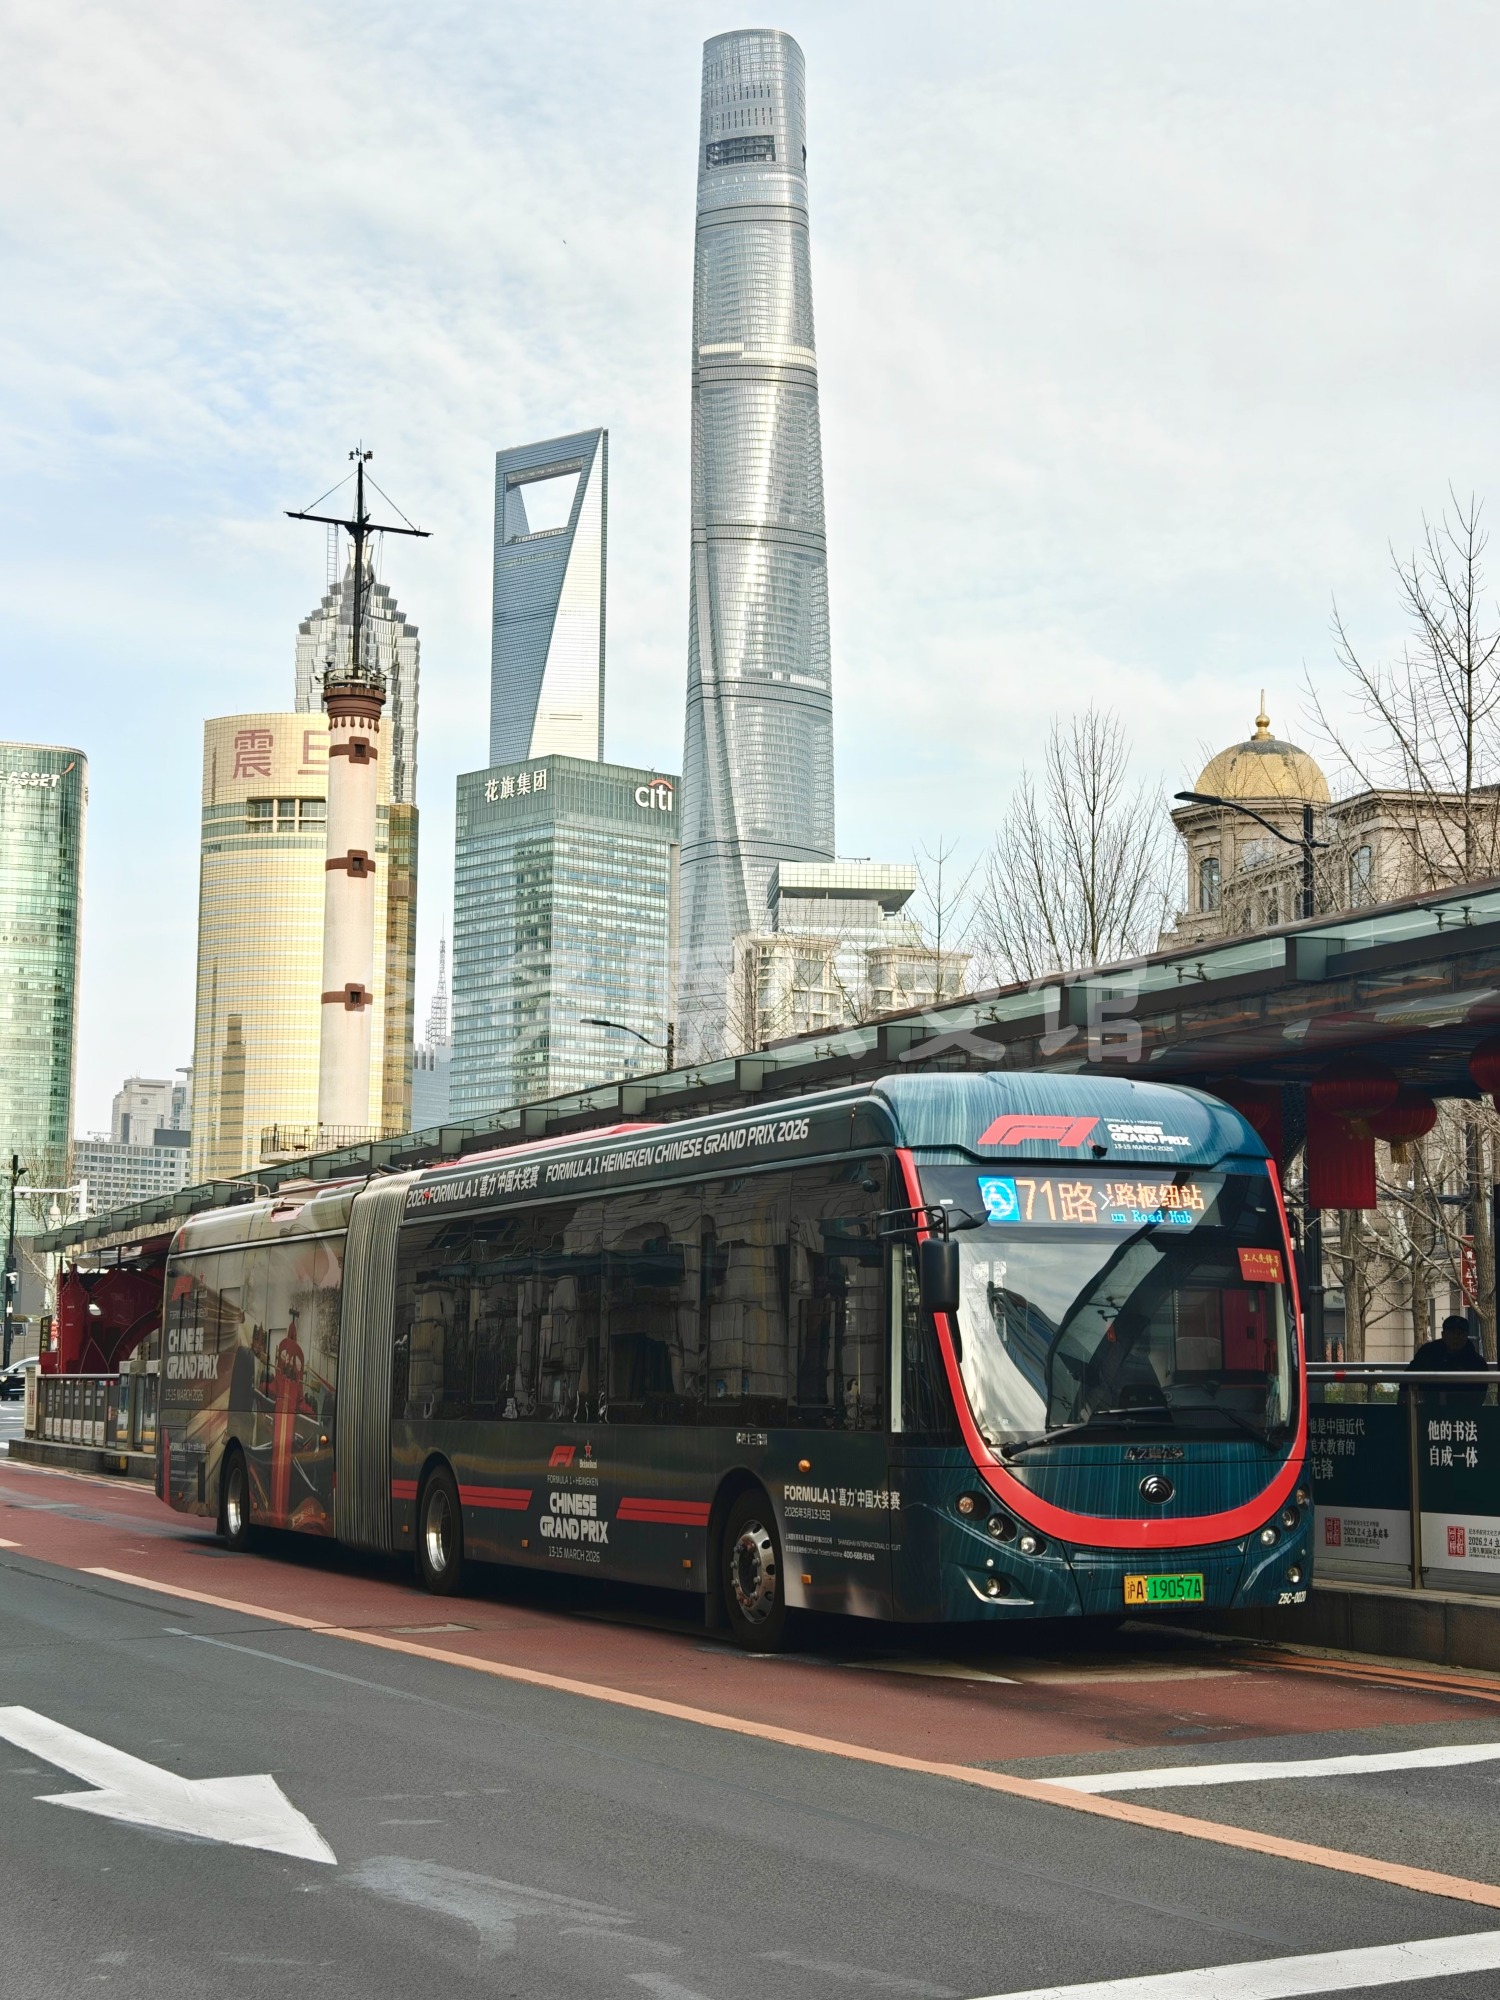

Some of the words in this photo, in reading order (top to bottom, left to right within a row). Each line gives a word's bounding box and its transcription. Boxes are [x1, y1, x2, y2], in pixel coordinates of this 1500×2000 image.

[7, 771, 61, 788] ASSET
[485, 768, 547, 803] 花旗集团
[635, 779, 673, 811] citi
[1107, 1123, 1164, 1135] CHINESE
[1111, 1132, 1158, 1144] GRAND
[1158, 1135, 1191, 1146] PRIX
[546, 1158, 592, 1182] FORMULA
[592, 1156, 599, 1175] 1
[600, 1146, 656, 1173] HEINEKEN
[654, 1136, 704, 1164] CHINESE
[704, 1128, 746, 1155] GRAND
[747, 1122, 778, 1147] PRIX
[777, 1117, 810, 1143] 2026
[428, 1179, 472, 1205] FORMULA
[1015, 1179, 1097, 1222] 71路
[1134, 1210, 1164, 1224] Road
[1169, 1211, 1193, 1224] Hub
[167, 1355, 197, 1379] GRAND
[196, 1354, 219, 1379] PRIX
[1428, 1419, 1478, 1442] 他的书法
[1429, 1445, 1478, 1468] 自成一体
[547, 1474, 568, 1485] FORMULA
[576, 1476, 599, 1487] HEINEKEN
[549, 1491, 597, 1517] CHINESE
[784, 1485, 829, 1503] FORMULA
[830, 1487, 836, 1504] 1
[540, 1515, 580, 1541] GRAND
[580, 1518, 609, 1544] PRIX
[548, 1545, 563, 1558] 13-15
[563, 1547, 585, 1561] MARCH
[585, 1550, 600, 1563] 2026
